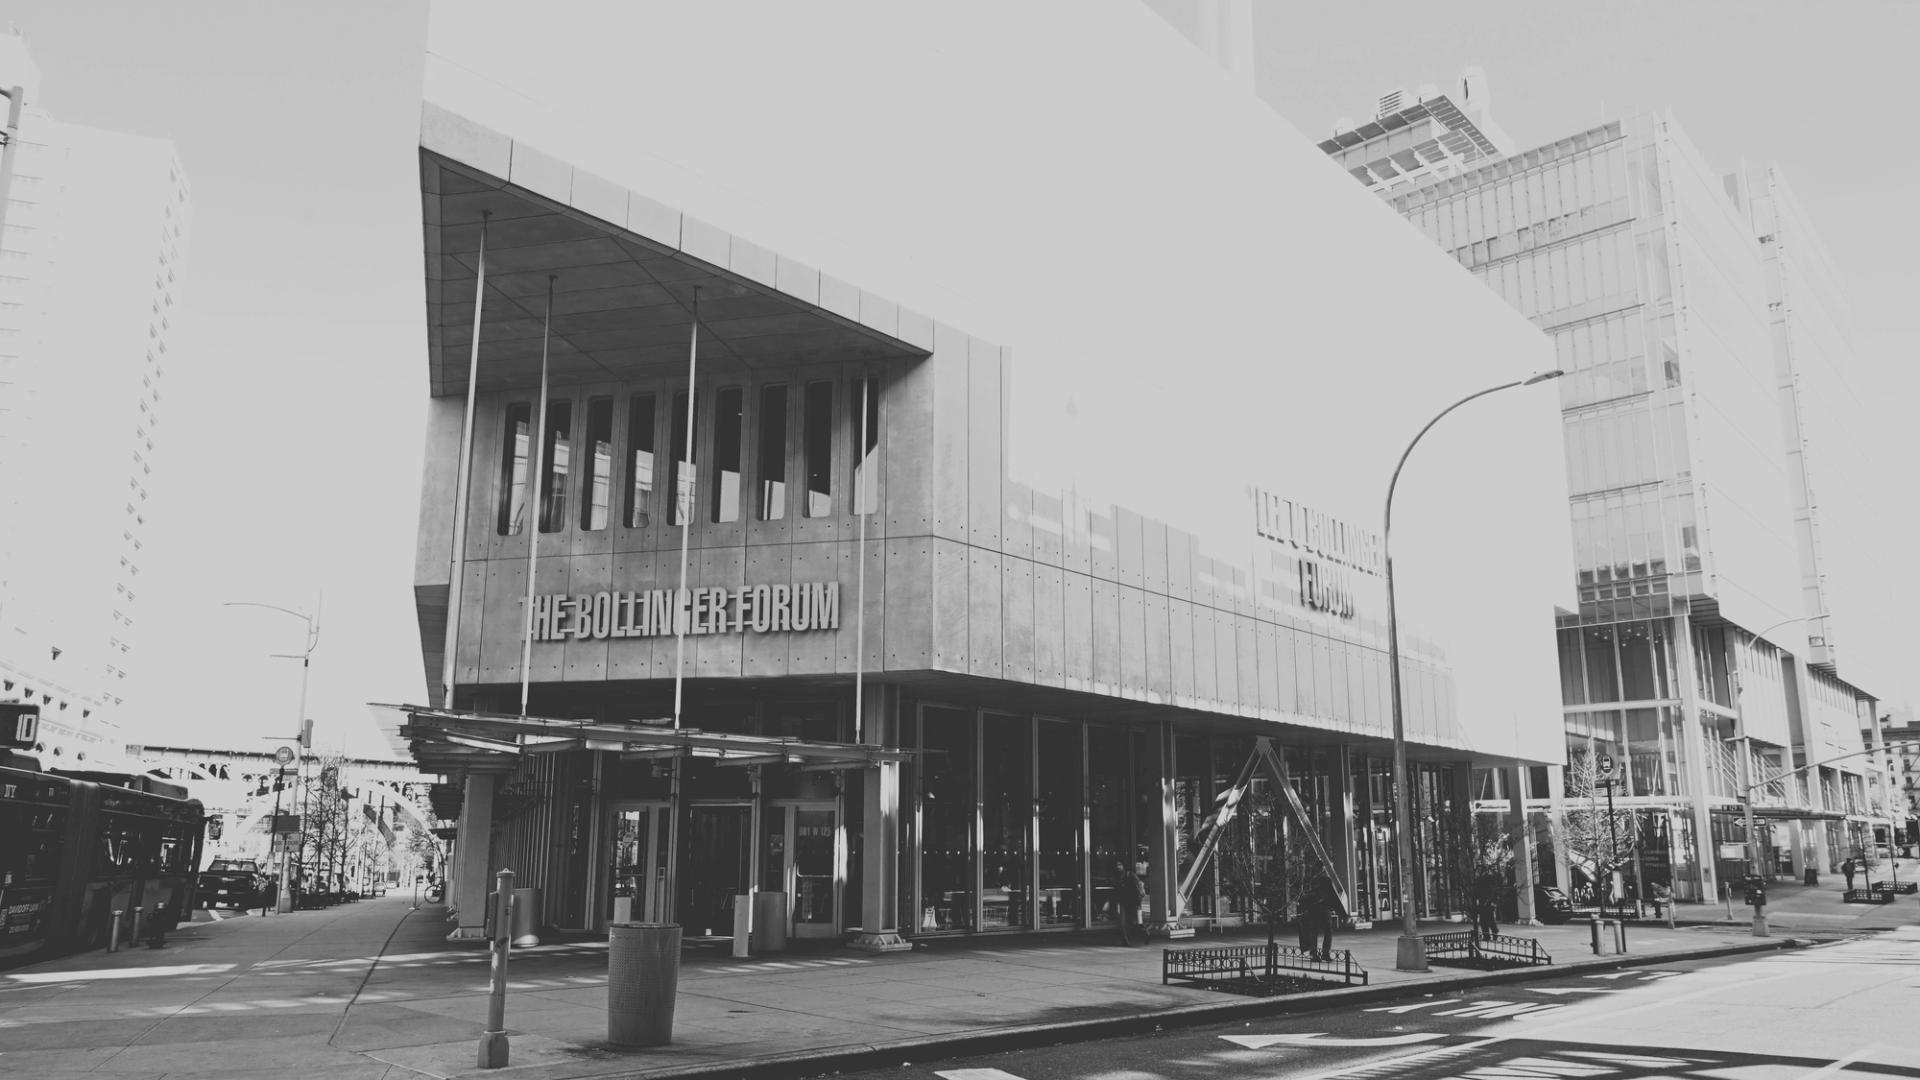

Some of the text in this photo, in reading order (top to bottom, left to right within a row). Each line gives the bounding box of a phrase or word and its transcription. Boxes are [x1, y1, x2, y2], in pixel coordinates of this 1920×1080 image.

[574, 586, 727, 640] BOLLINGER
[736, 581, 839, 633] FORUM
[1298, 559, 1354, 619] FORUM
